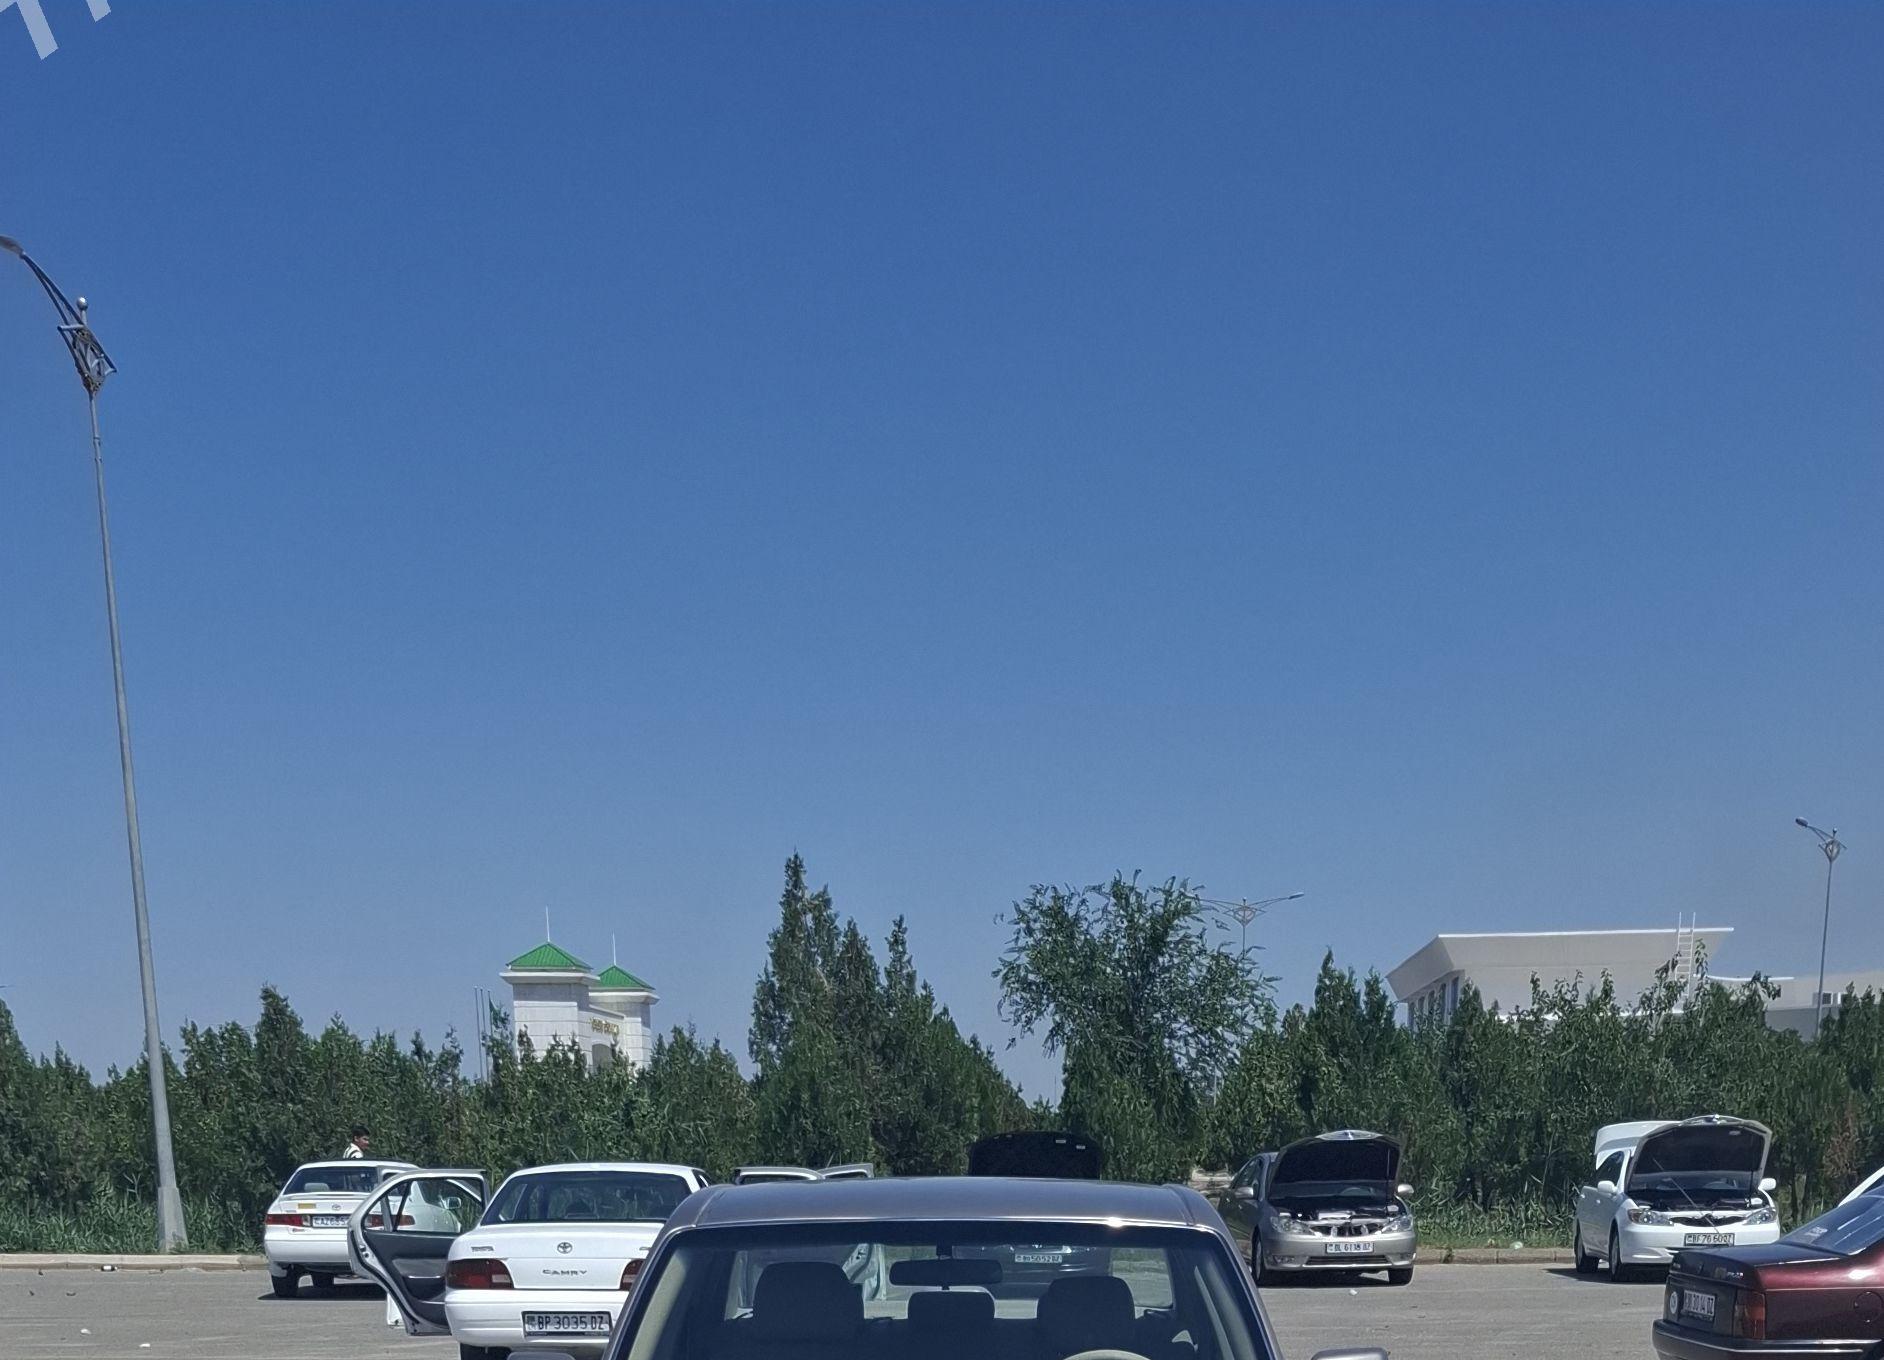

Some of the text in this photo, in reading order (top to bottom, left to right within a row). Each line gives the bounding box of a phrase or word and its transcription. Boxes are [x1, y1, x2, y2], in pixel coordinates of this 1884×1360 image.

[542, 1268, 588, 1277] CAMRY
[537, 1315, 604, 1330] BP 3035 DZ
